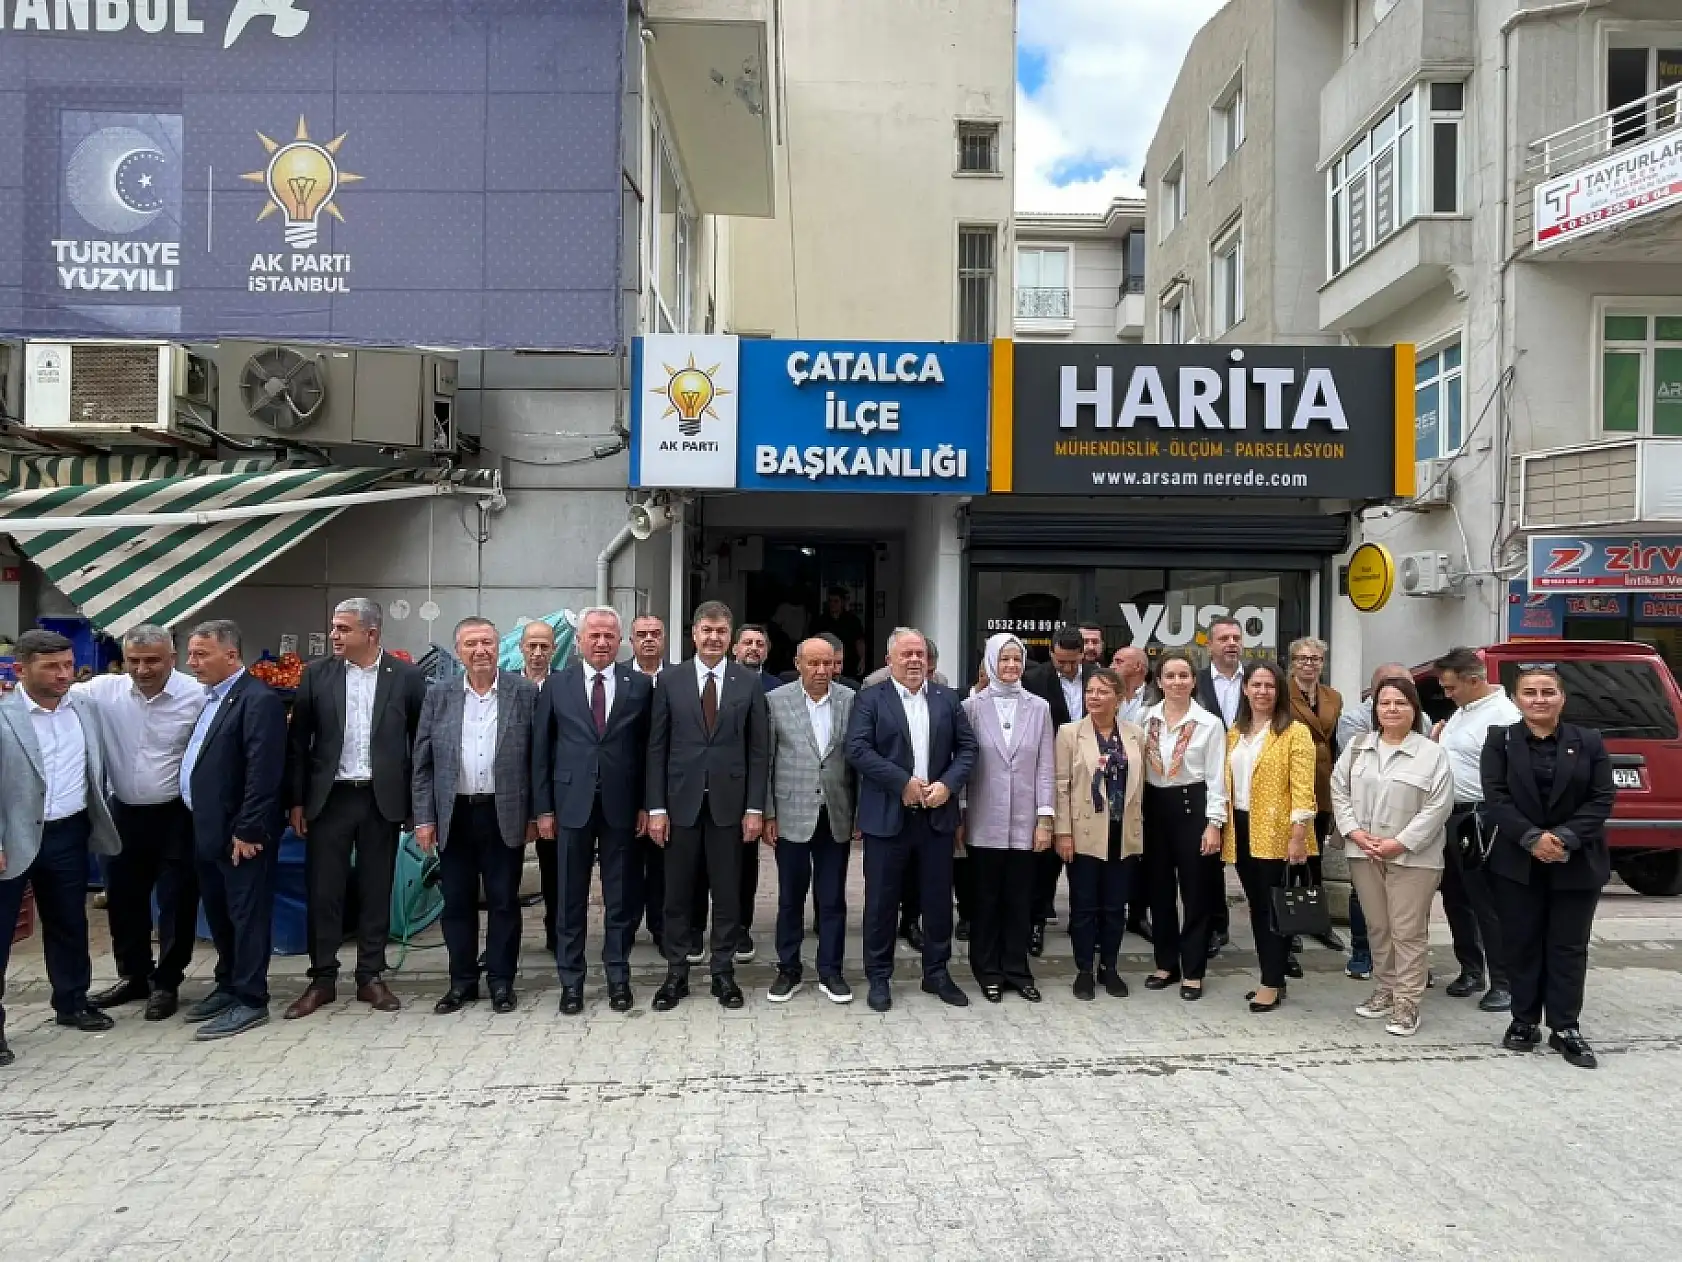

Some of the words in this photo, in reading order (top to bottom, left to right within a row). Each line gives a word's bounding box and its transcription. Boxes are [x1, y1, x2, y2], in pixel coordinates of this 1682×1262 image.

[250, 253, 284, 272] AK
[57, 266, 174, 291] YÜZYILI
[248, 275, 350, 293] İSTANBUL
[786, 351, 945, 386] ÇATALCA
[1059, 348, 1350, 431] HARİTA
[825, 391, 900, 435] İLÇE
[659, 440, 678, 452] AK
[1055, 436, 1160, 457] MÜHENDİSLİK
[1169, 436, 1223, 461] ÖLÇÜM
[1235, 441, 1344, 459] PARSELASYON
[755, 443, 967, 480] BAŞKANLIĞI
